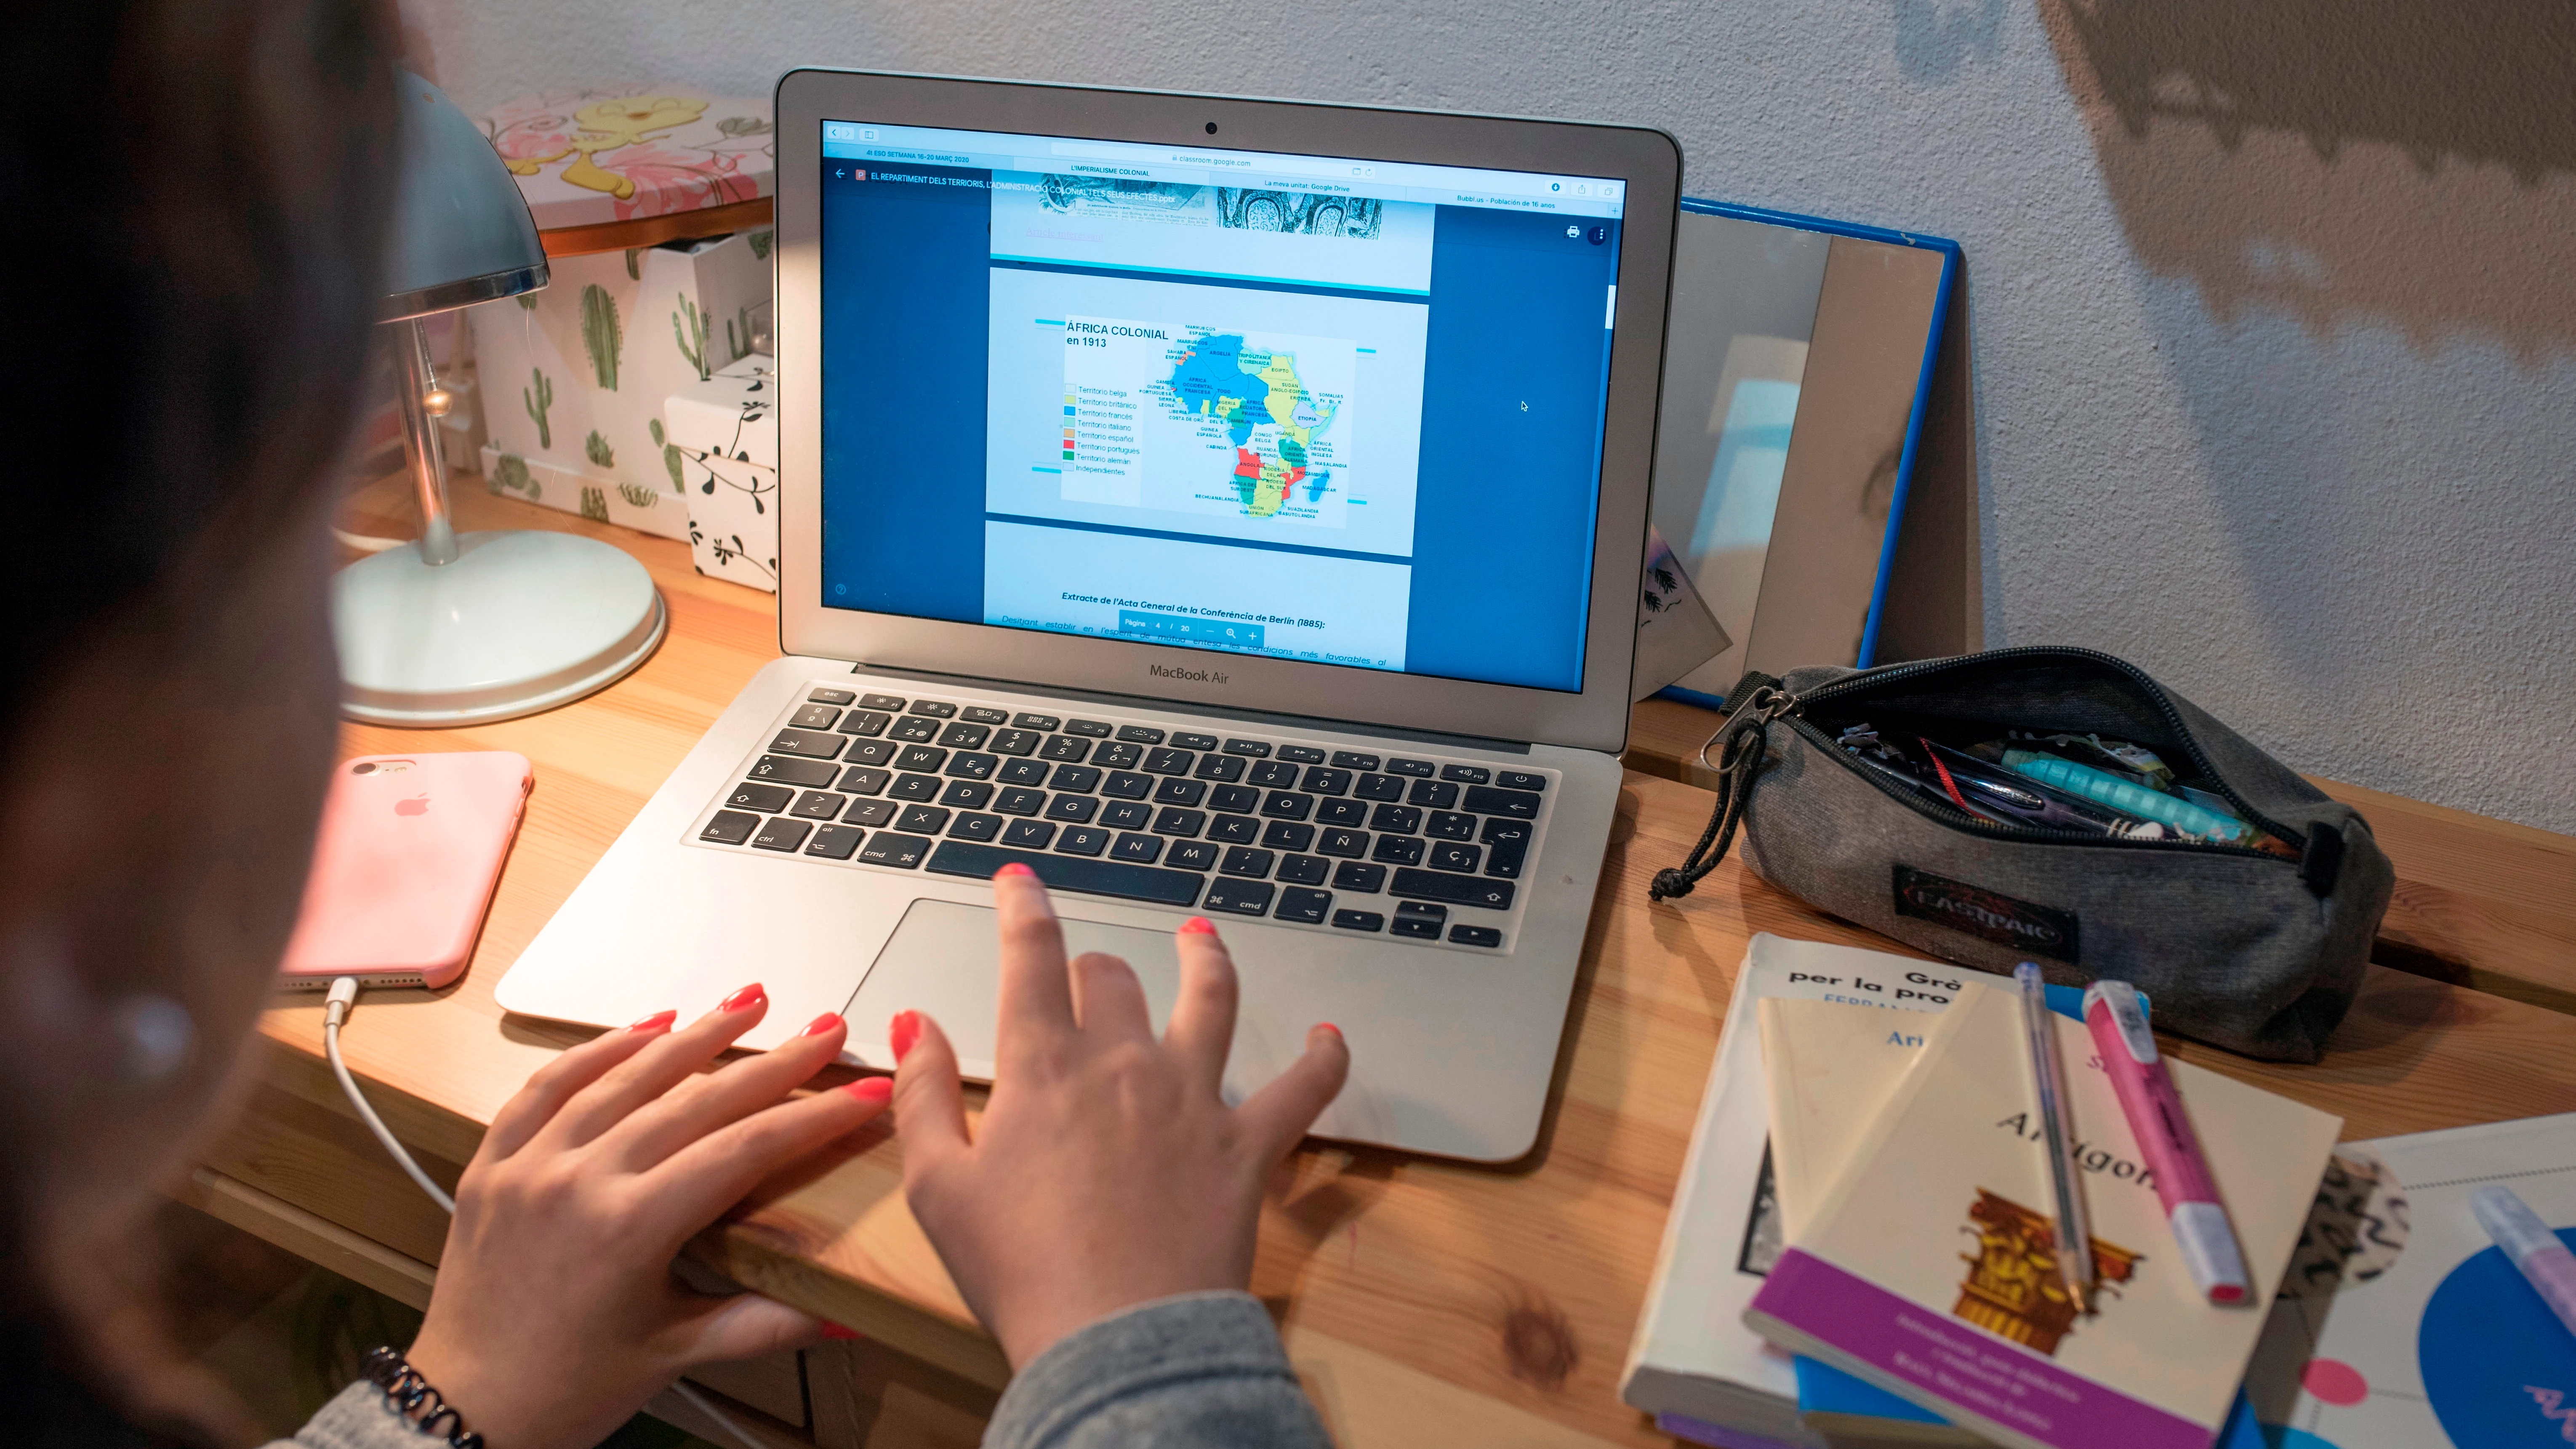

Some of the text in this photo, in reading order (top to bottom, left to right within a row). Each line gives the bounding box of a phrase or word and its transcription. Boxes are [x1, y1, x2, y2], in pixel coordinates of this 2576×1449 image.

[1180, 155, 1251, 167] classroom.google.com
[1071, 165, 1117, 174] L'IMPERIALISME
[881, 173, 928, 184] REPARTIMENT
[948, 178, 986, 189] TERRIORIS,
[1050, 186, 1088, 197] COLONIAL
[1093, 189, 1106, 198] ELS
[1107, 191, 1125, 199] SEUS
[1126, 192, 1176, 204] EFECTES.pptx
[1026, 226, 1055, 237] Article
[1067, 320, 1169, 340] ÁFRICA COLONIAL
[1082, 337, 1106, 347] 1913
[1079, 386, 1108, 395] Territorio
[1078, 397, 1137, 409] Territorio británico
[1078, 409, 1132, 420] Territorio francés
[1077, 420, 1106, 429] Territorio
[1077, 431, 1134, 443] Territorio español
[1077, 442, 1140, 455] Territorio portugués
[1076, 453, 1131, 465] Territorio alemán
[1076, 465, 1125, 476] Independientes
[1062, 592, 1098, 603] Extracte
[1113, 598, 1138, 607] l'Acta
[1141, 601, 1175, 612] General
[1200, 608, 1253, 621] Conferència
[1255, 613, 1267, 622] de
[1269, 615, 1295, 625] Berlín
[1297, 618, 1325, 629] (1885):
[1125, 618, 1145, 627] Pàgina
[1002, 615, 1039, 626] Desitjant
[1045, 621, 1076, 631] establir
[1100, 626, 1132, 637] l'esperit
[1158, 633, 1186, 643] mútua
[1193, 638, 1221, 647] entesa
[1247, 644, 1293, 656] condicions
[1300, 650, 1318, 658] més
[1326, 652, 1371, 665] favorables
[1150, 664, 1229, 684] MacBook Air
[914, 752, 929, 762] W
[1018, 767, 1028, 775] R
[856, 775, 867, 783] A
[908, 782, 919, 790] S
[1174, 786, 1186, 795] U
[960, 789, 972, 797] D
[1119, 810, 1132, 818] H
[1228, 823, 1239, 832] K
[1337, 835, 1350, 846] Ñ
[1183, 848, 1199, 859] M
[1239, 901, 1261, 910] cmd
[1789, 972, 1843, 986] per
[1854, 977, 1883, 993] la
